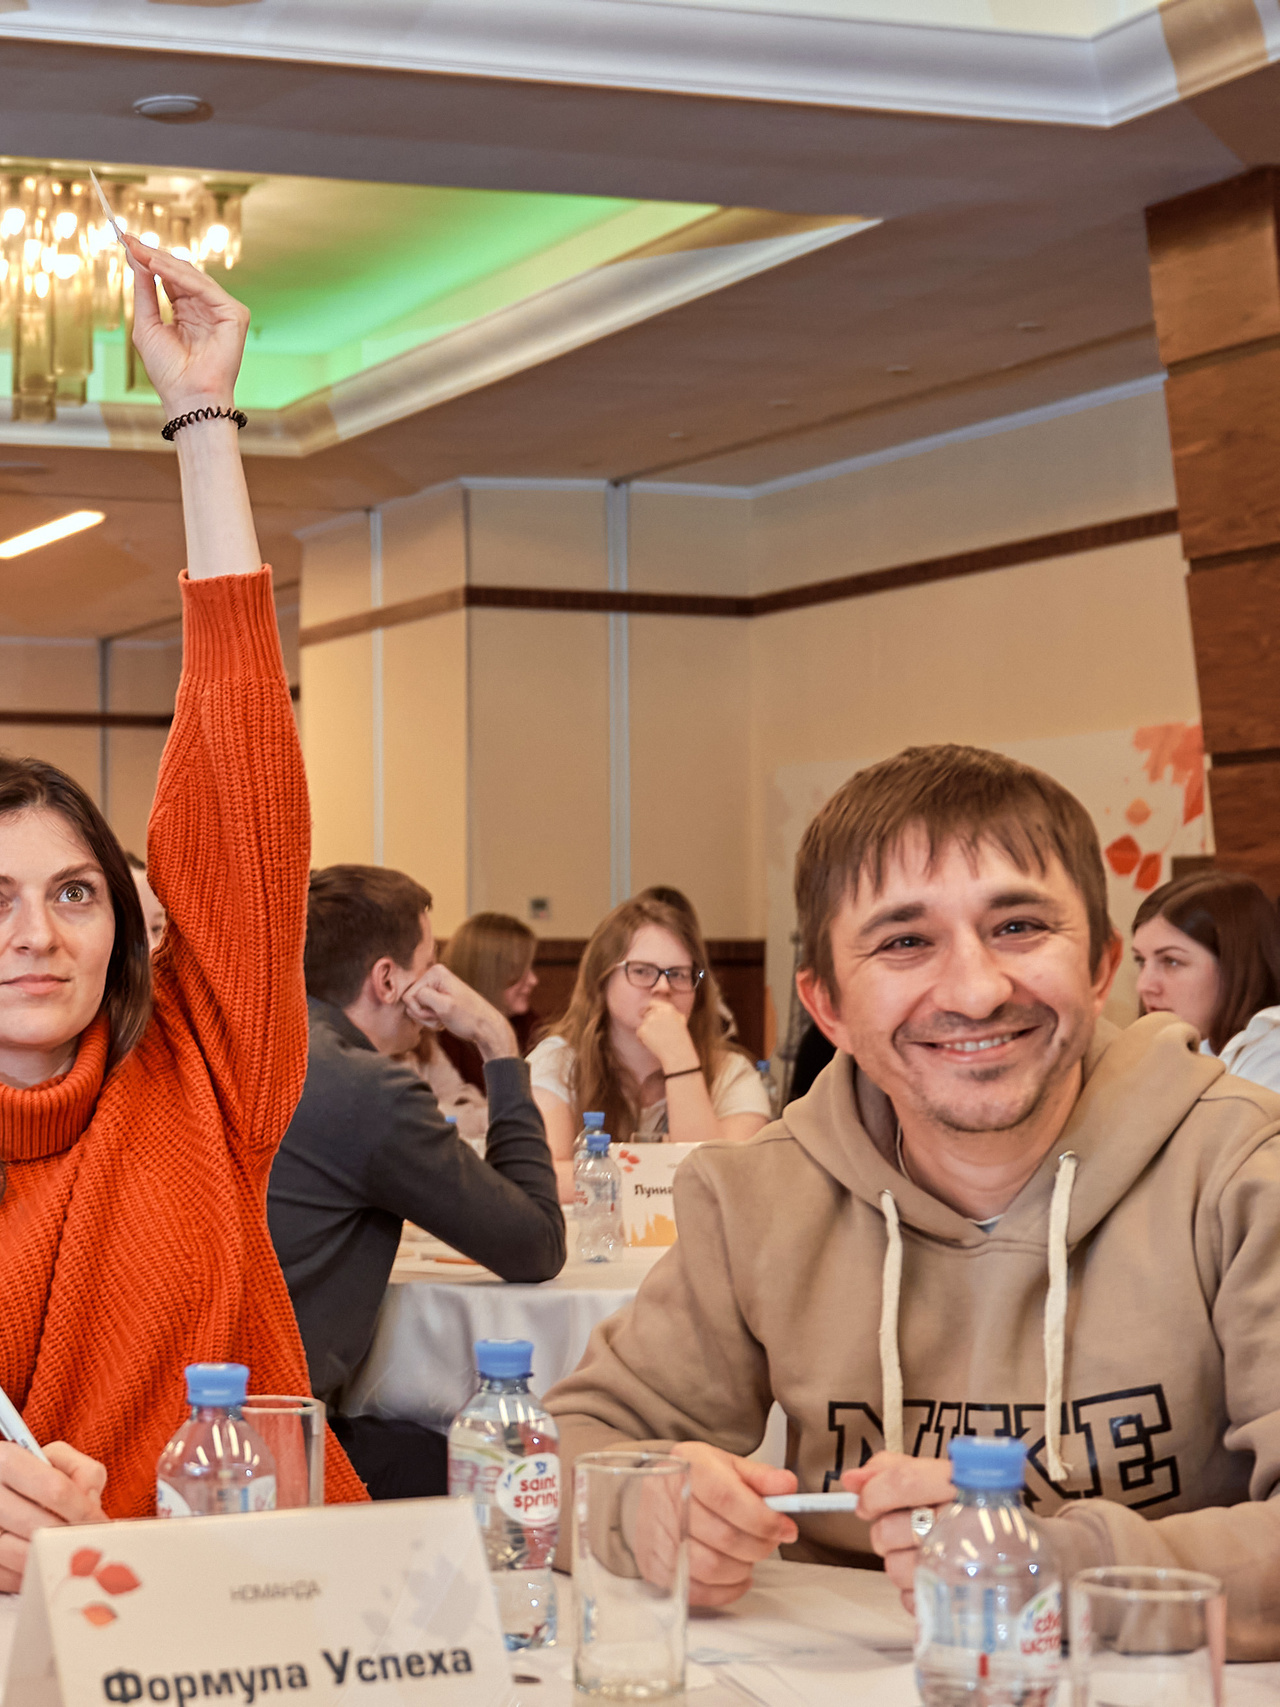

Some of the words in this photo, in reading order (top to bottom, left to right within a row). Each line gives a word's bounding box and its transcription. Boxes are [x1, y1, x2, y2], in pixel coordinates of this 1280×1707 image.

[822, 1384, 1181, 1509] NIKE
[520, 1475, 556, 1492] saint
[104, 1664, 308, 1707] Формула
[322, 1648, 472, 1685] Успеха
